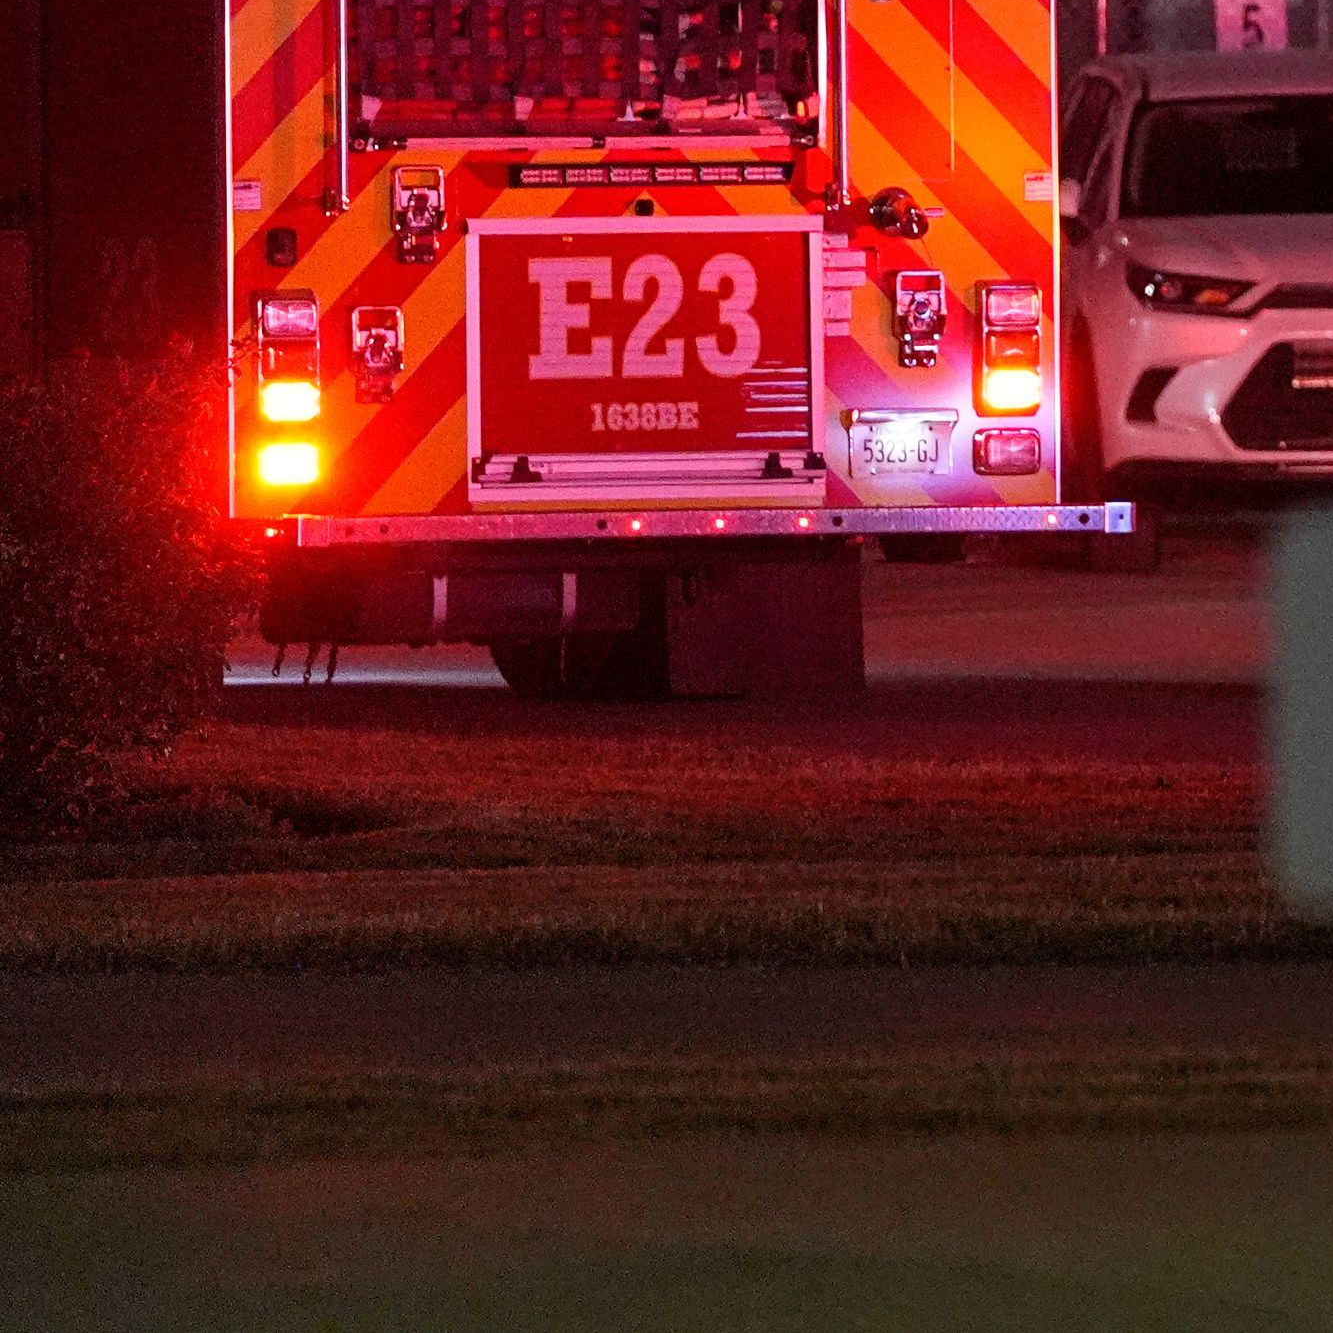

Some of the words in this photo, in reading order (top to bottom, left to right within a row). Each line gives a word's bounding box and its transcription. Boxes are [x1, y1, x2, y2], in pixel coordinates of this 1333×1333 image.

[1242, 3, 1264, 48] 5
[527, 254, 761, 380] E23
[863, 438, 940, 464] 5323-GJ
